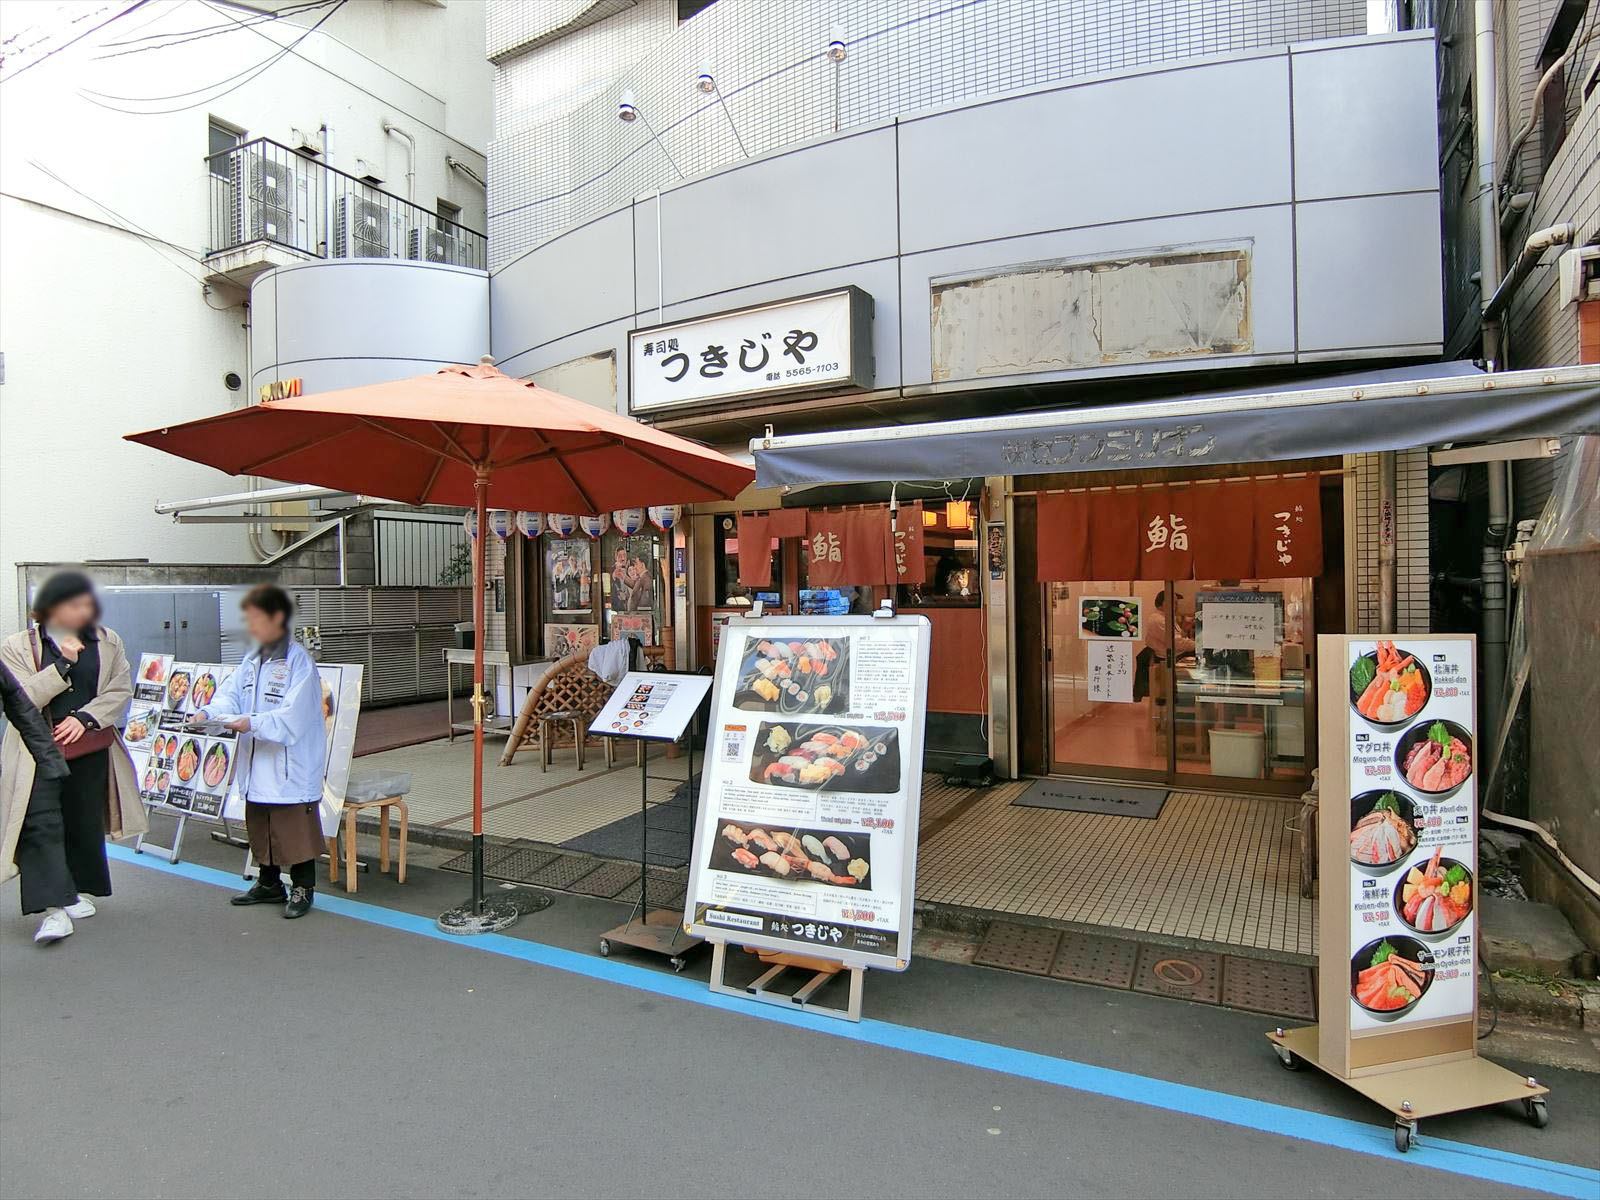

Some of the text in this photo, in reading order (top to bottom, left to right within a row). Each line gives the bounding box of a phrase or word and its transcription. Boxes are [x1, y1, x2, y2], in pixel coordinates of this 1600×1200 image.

[643, 337, 679, 357] 寿司処
[661, 329, 818, 382] つきじや
[766, 362, 839, 381] 電話 5565-1103
[1145, 514, 1189, 552] 鮨
[1273, 511, 1294, 567] つきじや
[811, 531, 842, 563] 鮨
[1356, 742, 1391, 753] マグロ丼
[1362, 888, 1390, 900] 海鮮丼
[709, 912, 761, 927] Sushi Restaurant
[791, 923, 844, 943] つきじや
